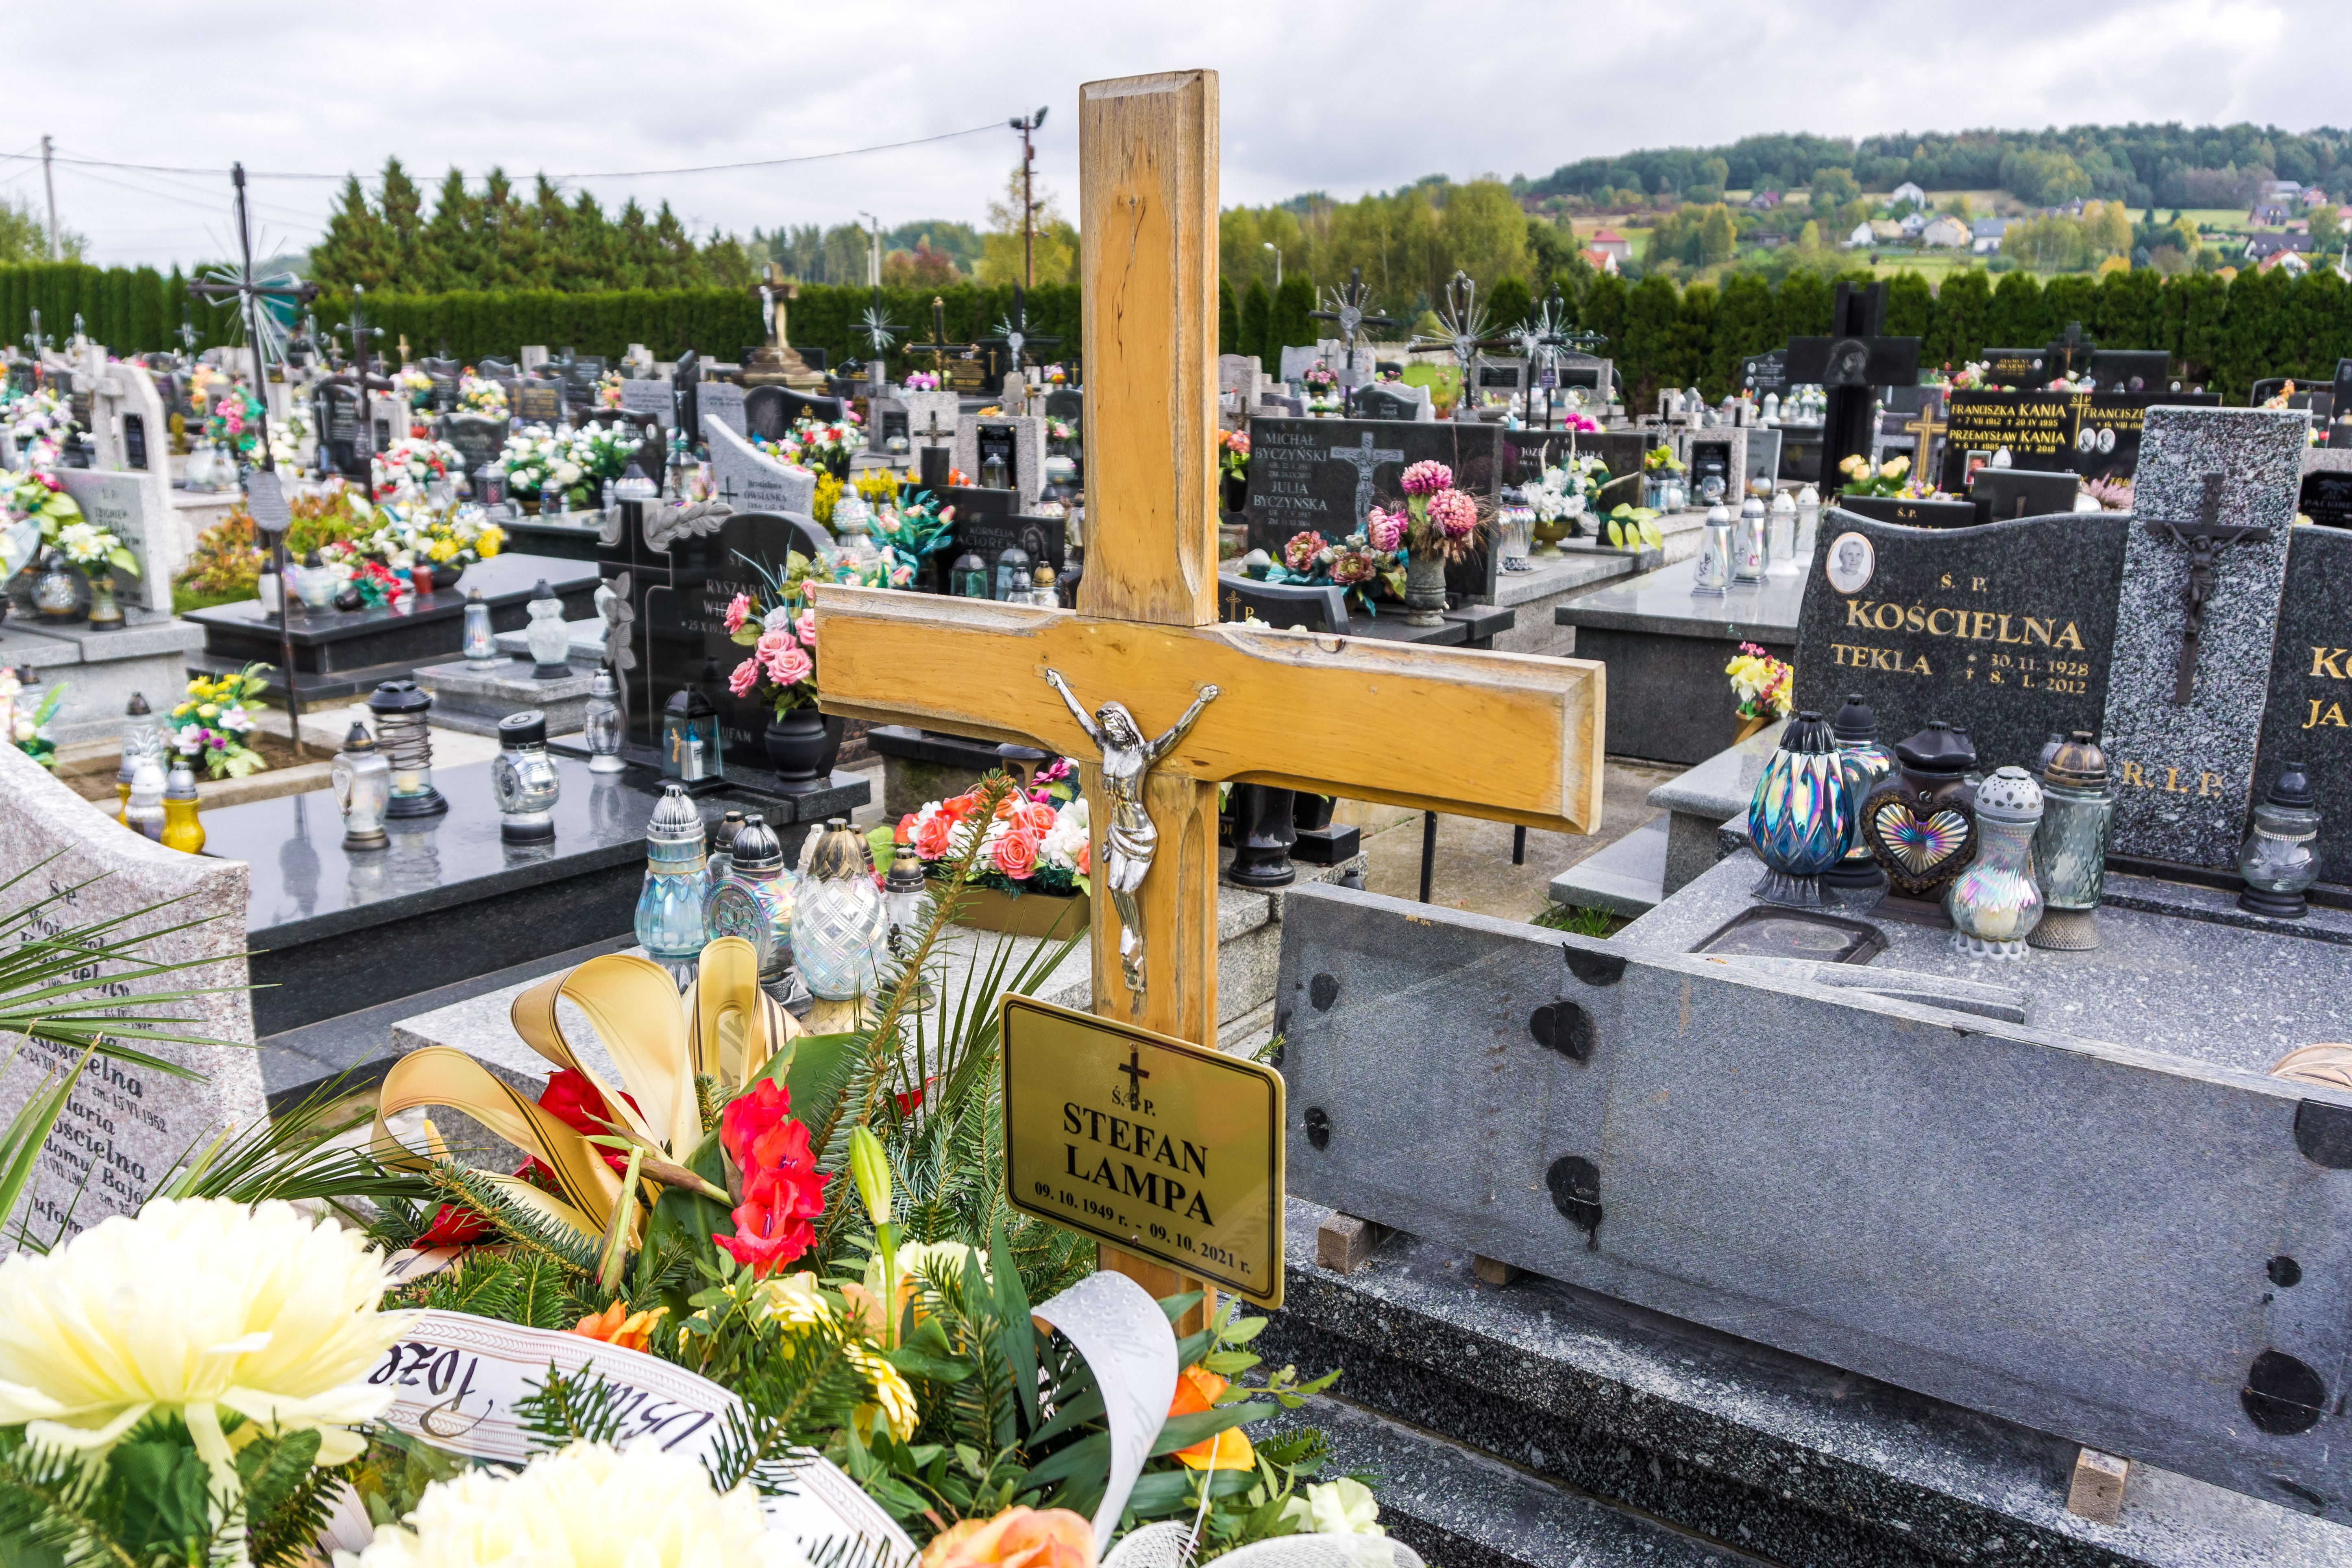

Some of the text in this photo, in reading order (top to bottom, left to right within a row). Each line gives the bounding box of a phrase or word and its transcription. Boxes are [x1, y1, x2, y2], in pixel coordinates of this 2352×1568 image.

[1951, 403, 2067, 418] FRANCISZKA KANIA
[2083, 407, 2145, 418] FRANCISZE
[1265, 432, 1316, 446] MICHAŁ
[1949, 429, 2066, 444] PRZEMYSŁAW KANIA
[1254, 446, 1327, 462] BYCZYŃSKI
[2036, 445, 2056, 453] 2018
[1272, 481, 1309, 494] JULIA
[1254, 494, 1328, 511] BYCZYŃSKA
[969, 526, 1014, 538] KORNELIA
[706, 579, 767, 599] RYSZARD
[1940, 571, 1988, 592] Ś. P.
[1845, 599, 2086, 651] KOŚCIELNA
[1831, 643, 1933, 675] TEKLA
[2048, 660, 2089, 677] 1928
[1989, 670, 2005, 684] 8.
[2046, 677, 2086, 694] 2012
[2302, 699, 2352, 729] JA
[721, 726, 751, 743] UFAM
[1111, 1085, 1156, 1117] Ś. P.
[142, 1108, 167, 1133] 1952
[1063, 1101, 1209, 1180] STEFAN
[44, 1134, 144, 1205] domu Bajo
[1064, 1143, 1216, 1227] LAMPA
[1034, 1181, 1054, 1200] 09.
[1059, 1190, 1078, 1209] 10.
[1083, 1198, 1114, 1221] 1949
[1118, 1214, 1128, 1228] r.
[1150, 1223, 1171, 1244] 09.
[1176, 1233, 1196, 1254] 10.
[1200, 1242, 1235, 1268] 2021
[1240, 1261, 1251, 1274] r.
